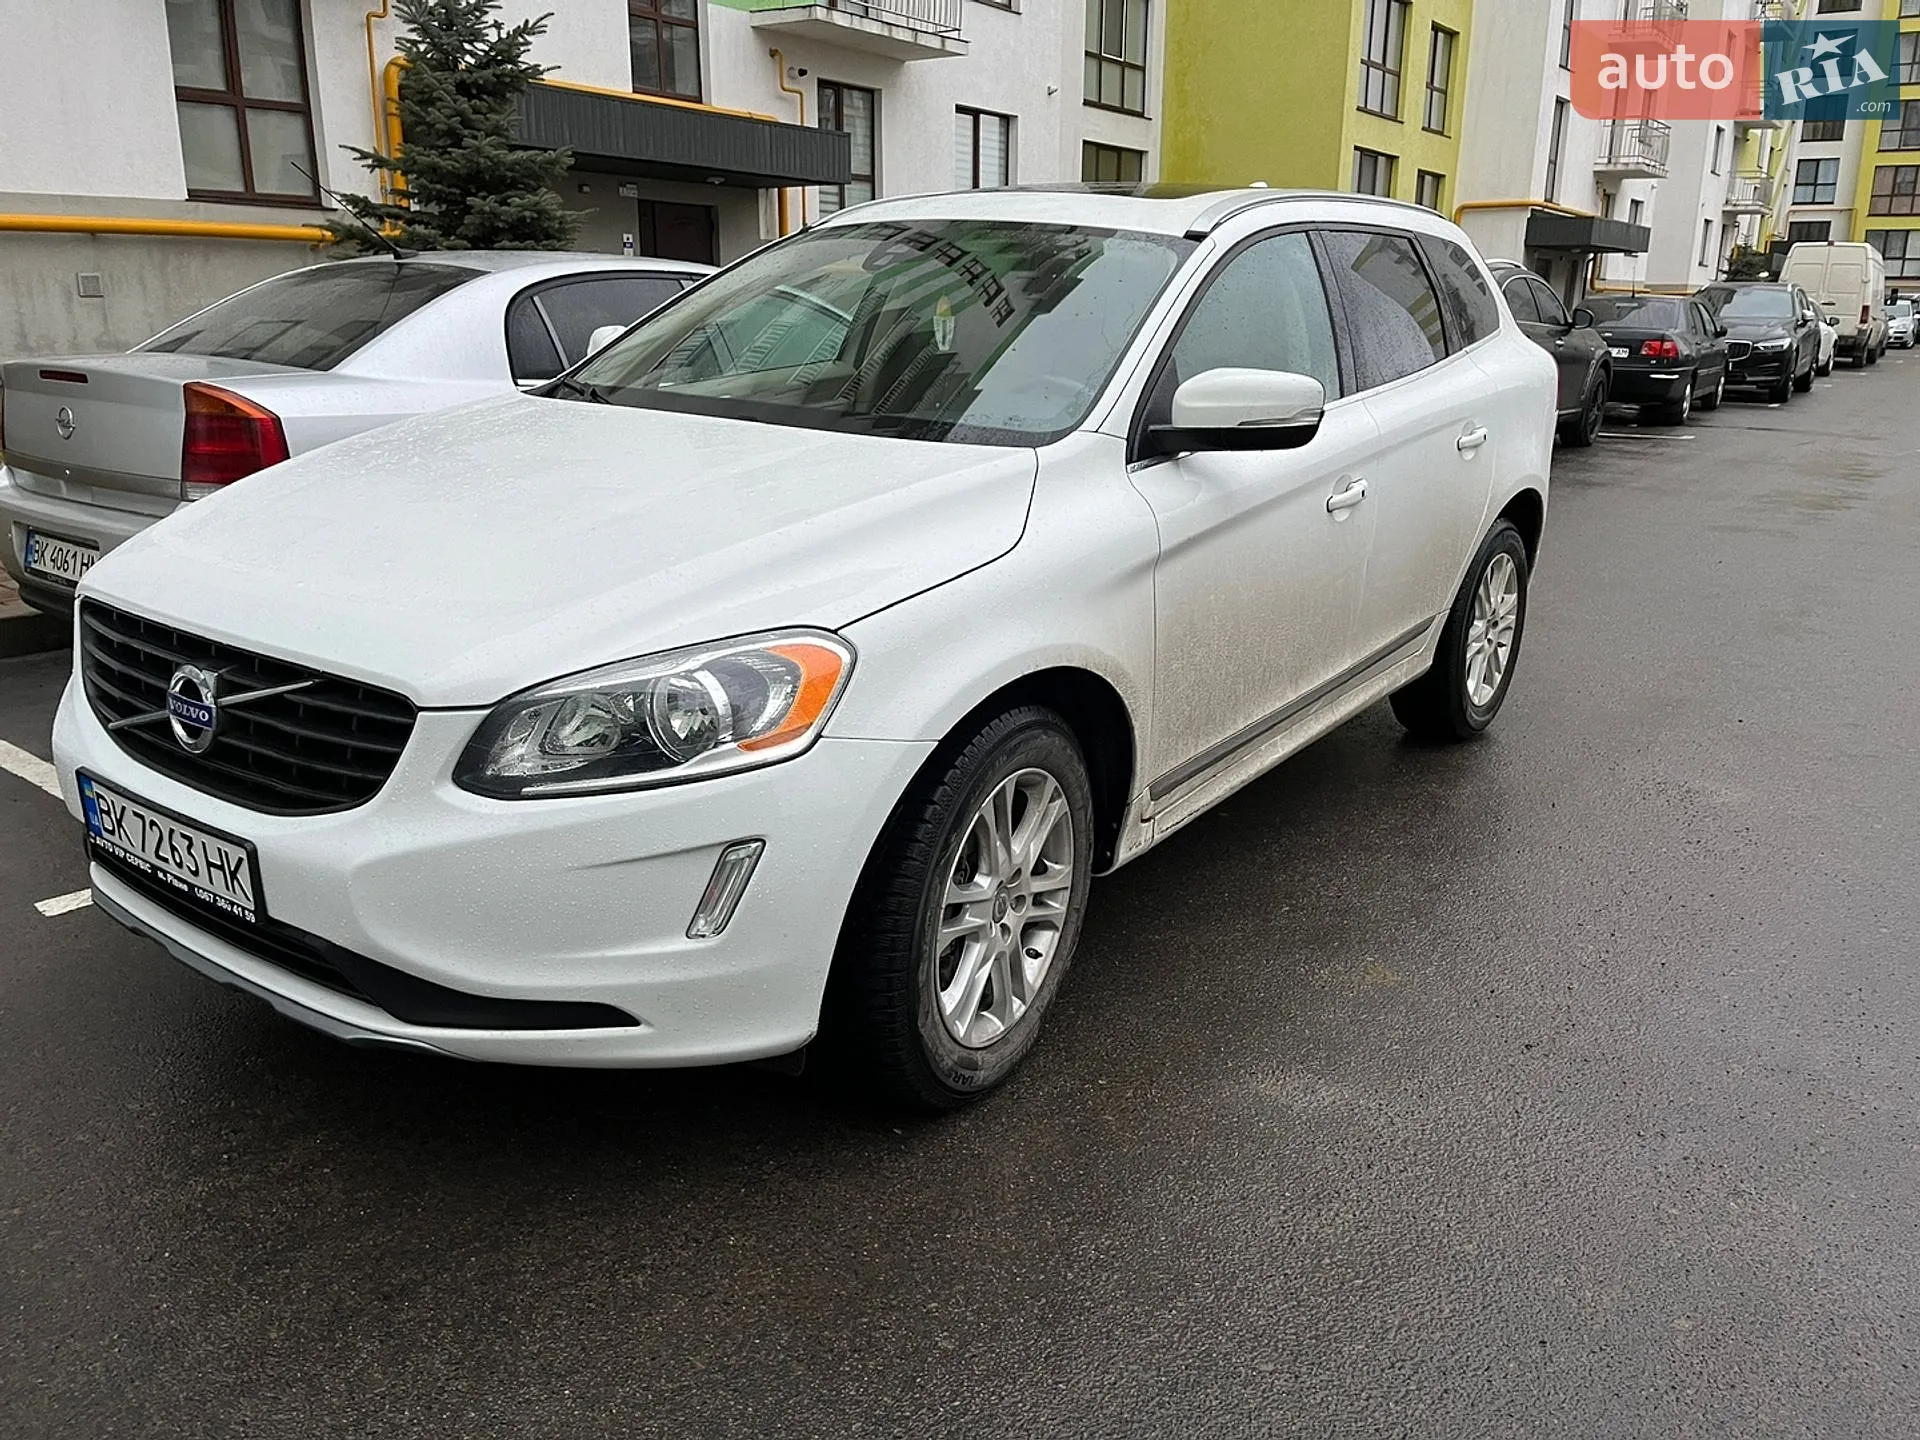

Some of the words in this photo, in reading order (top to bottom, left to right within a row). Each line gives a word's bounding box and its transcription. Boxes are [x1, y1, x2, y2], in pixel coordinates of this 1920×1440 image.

[33, 540, 49, 568] BK
[50, 545, 78, 575] 4061
[168, 696, 210, 722] VOLVO
[95, 790, 136, 848] BK
[131, 809, 200, 878] 7263
[201, 840, 252, 903] HK
